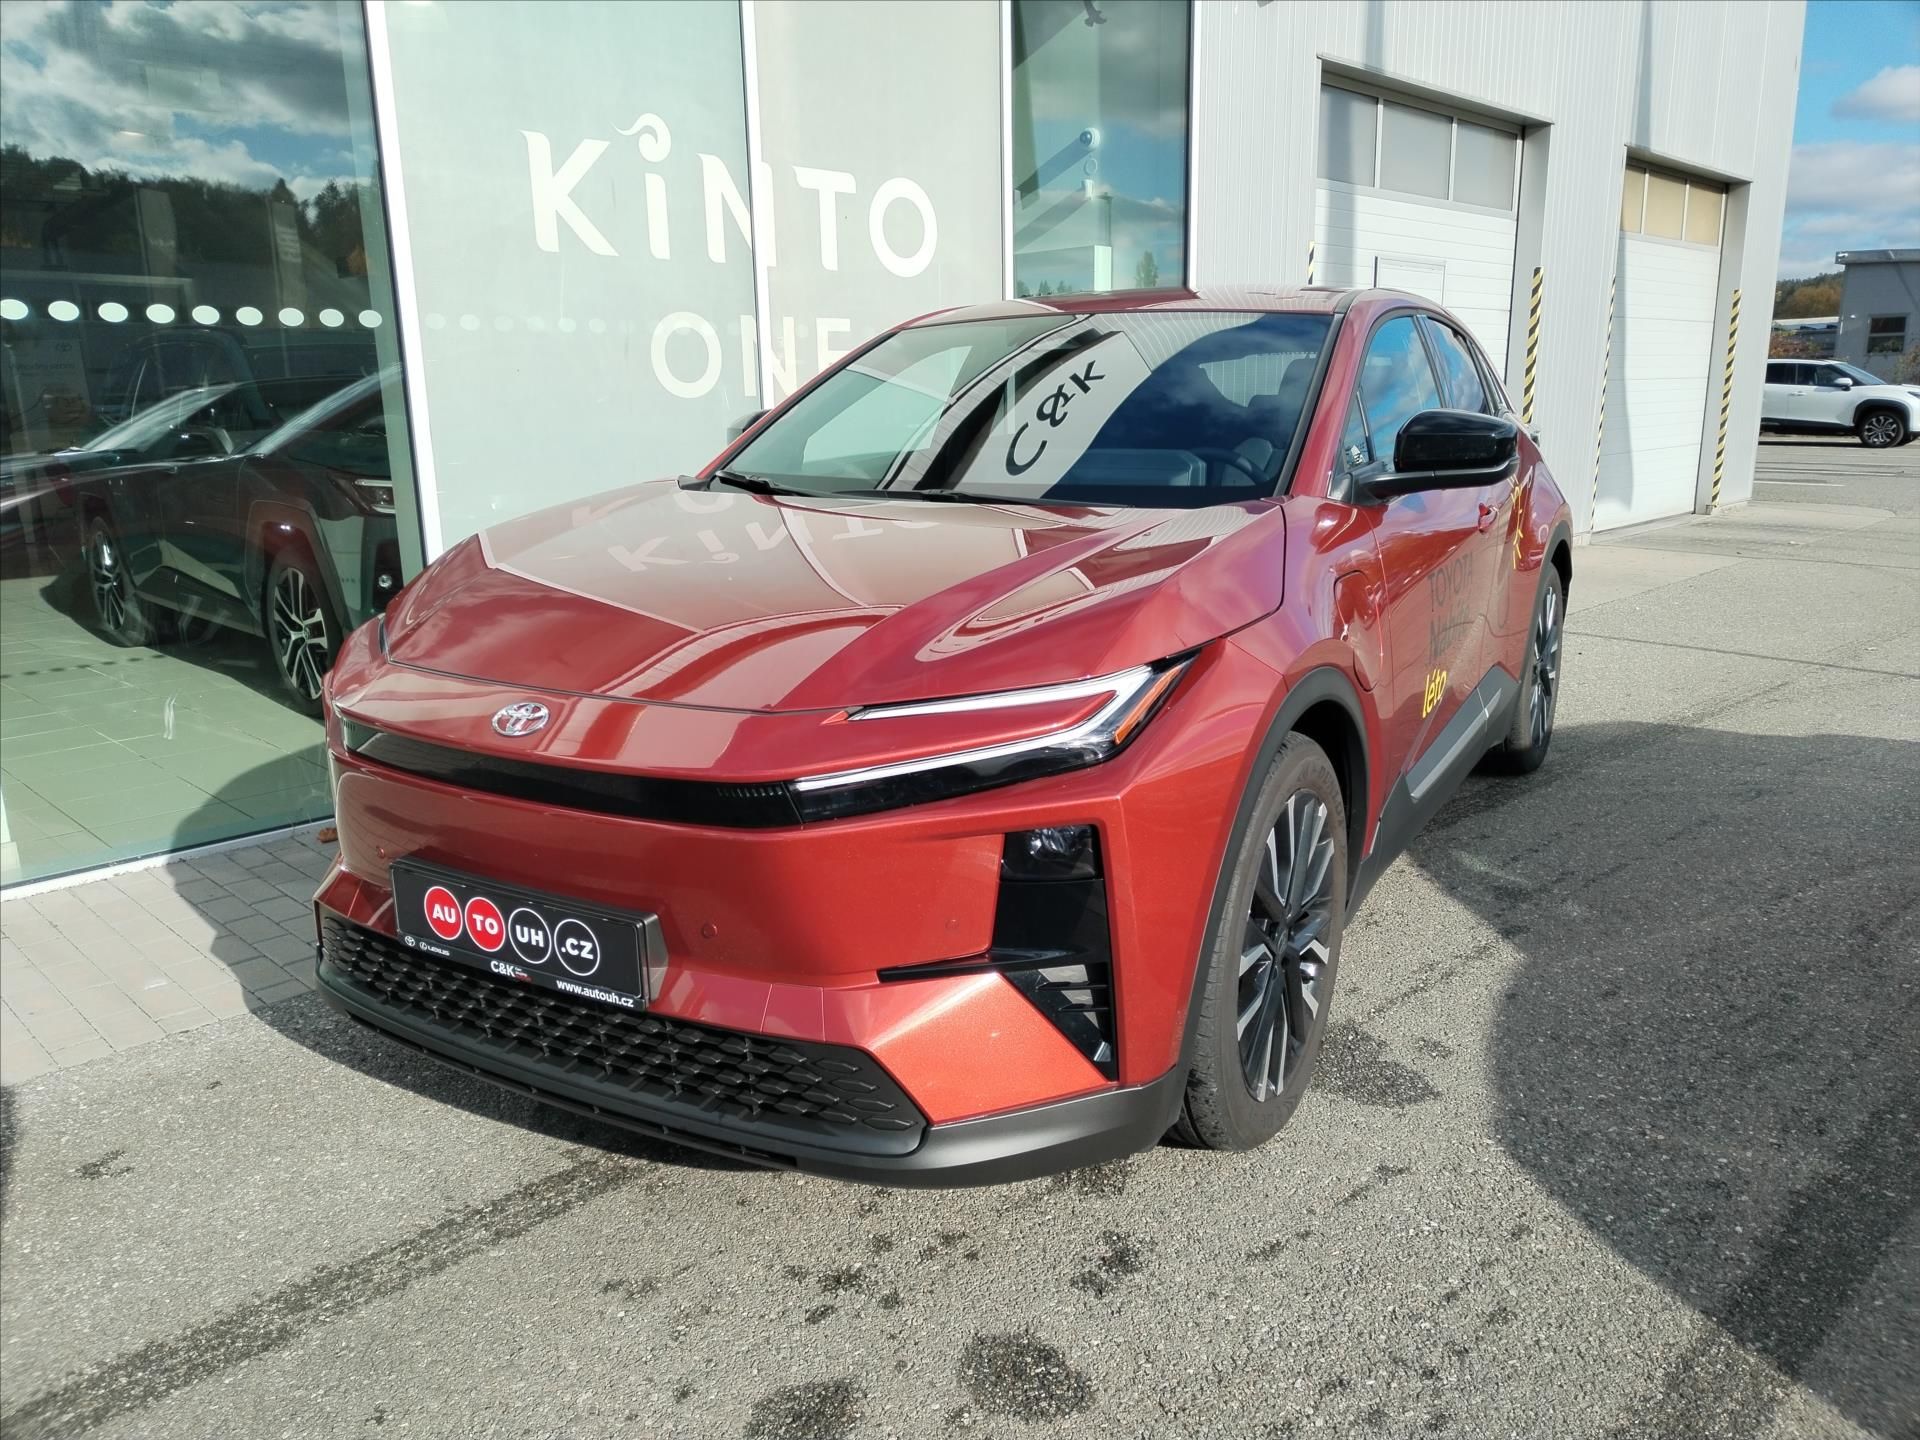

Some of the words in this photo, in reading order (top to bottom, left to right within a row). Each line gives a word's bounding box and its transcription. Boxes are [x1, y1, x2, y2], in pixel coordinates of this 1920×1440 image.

[1422, 666, 1447, 719] léto
[432, 903, 457, 924] AU
[472, 913, 499, 935] TO
[515, 924, 545, 948] UH
[561, 937, 594, 960] .CZ
[490, 960, 516, 978] C&K
[556, 979, 635, 1008] www.autouh.cz
